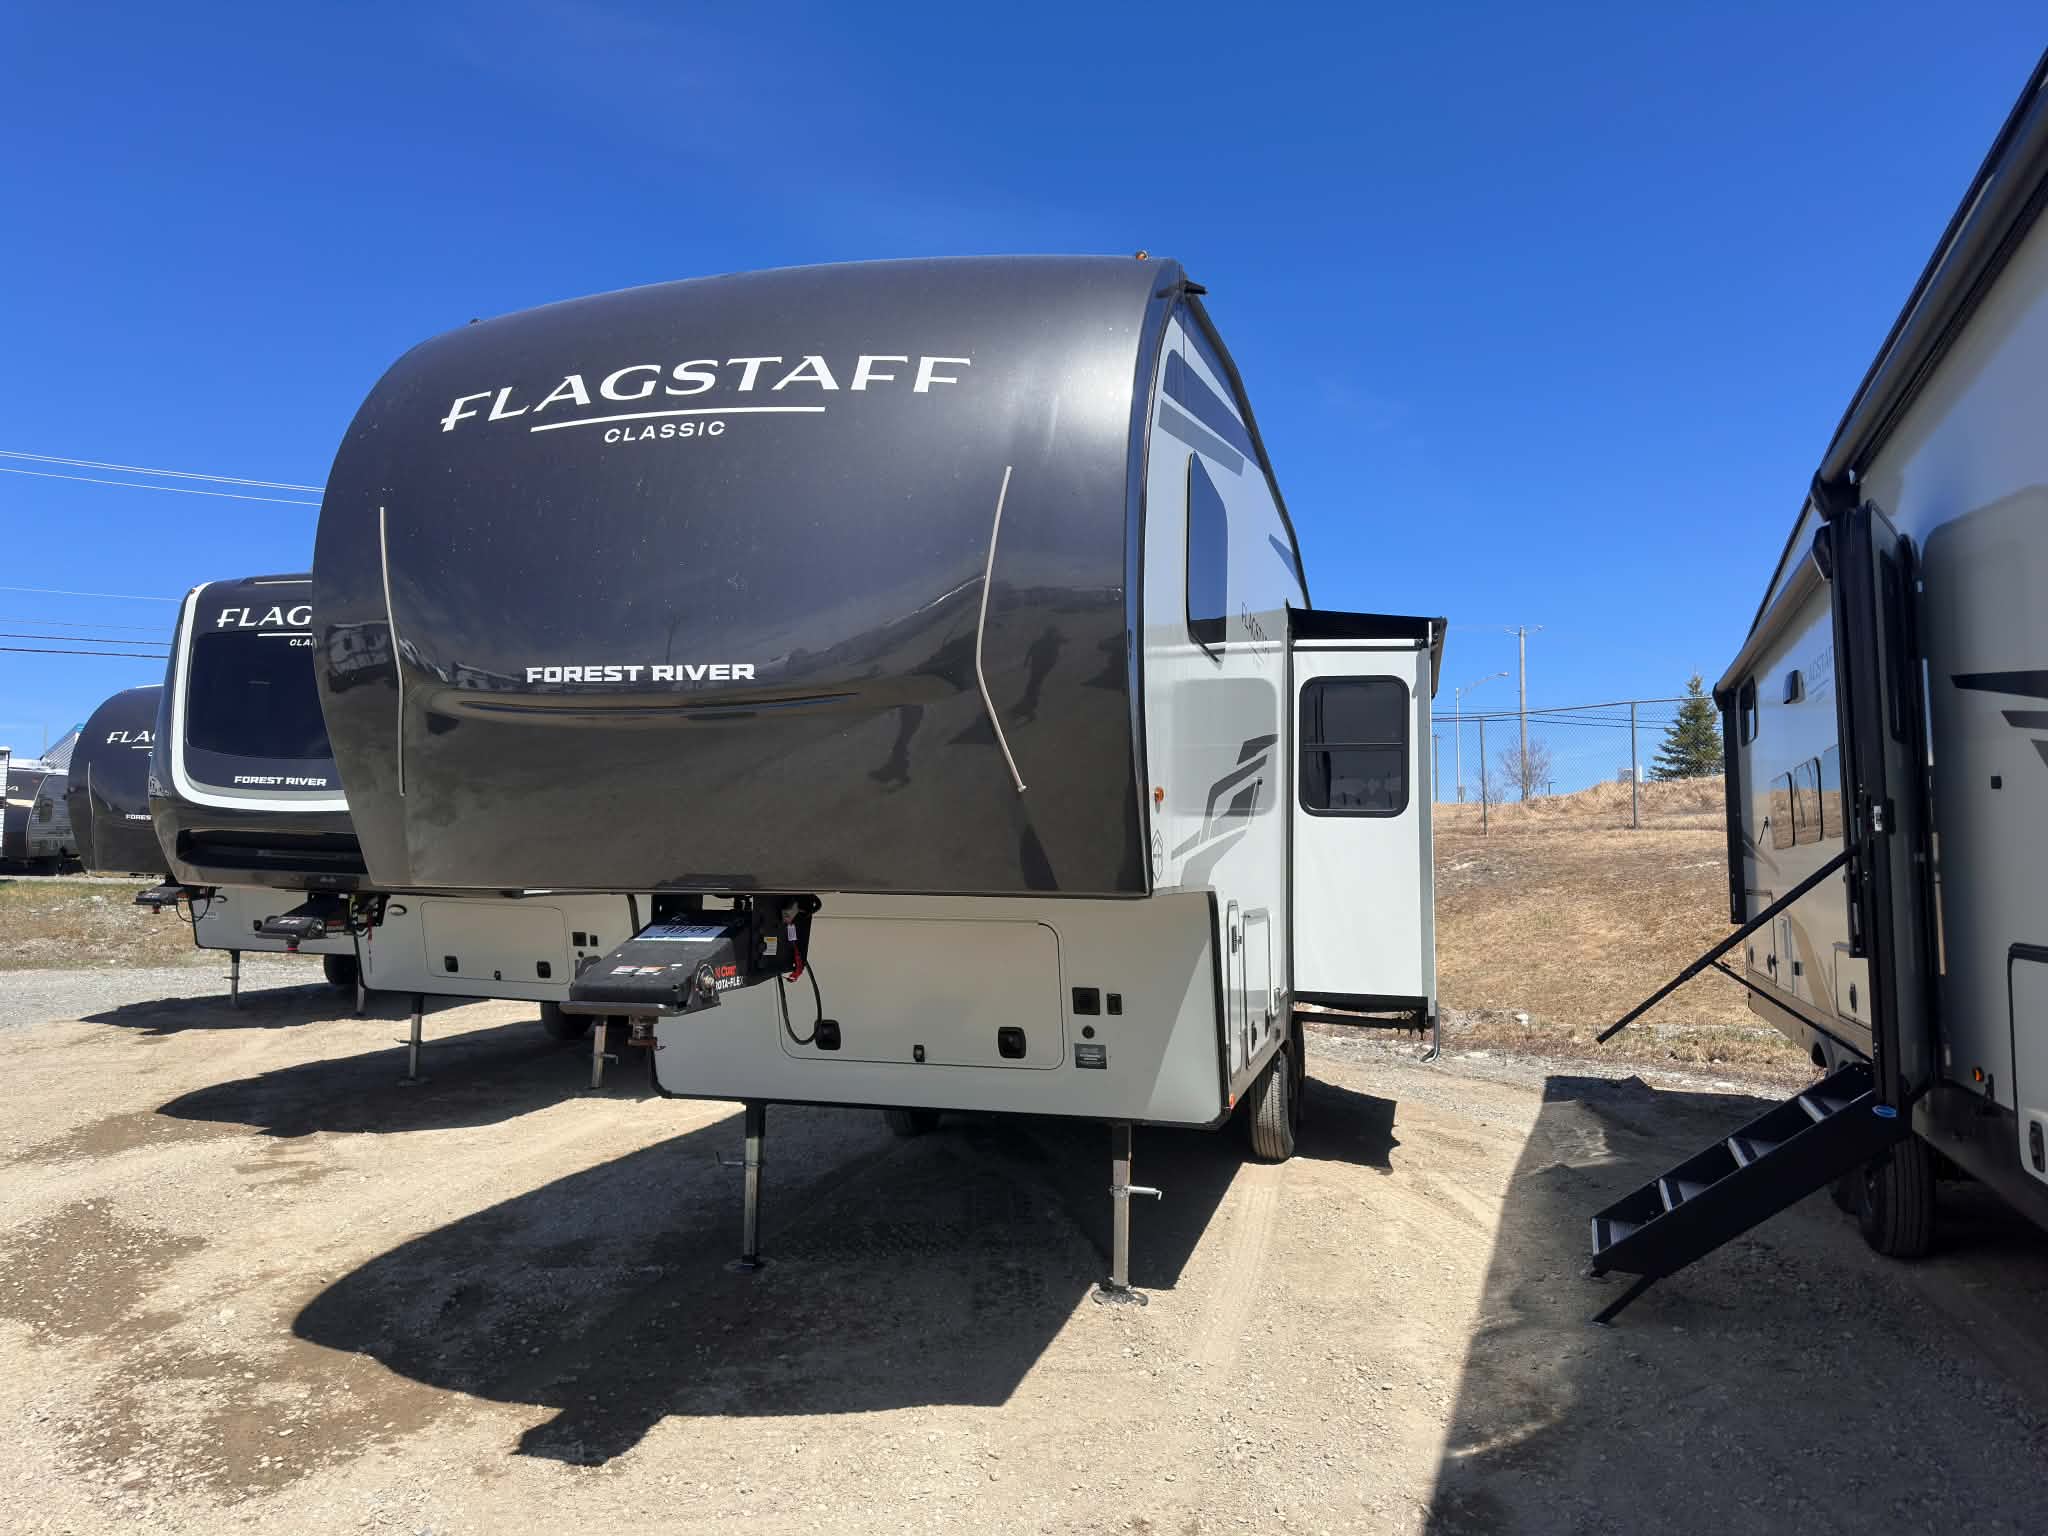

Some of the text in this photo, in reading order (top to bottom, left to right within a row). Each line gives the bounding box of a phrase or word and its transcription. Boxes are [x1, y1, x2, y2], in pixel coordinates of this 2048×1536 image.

[440, 355, 971, 432] FLAGSTAFF
[604, 421, 726, 444] CLASSIC
[289, 638, 312, 647] CLA
[526, 664, 756, 683] FOREST RIVER
[234, 776, 327, 787] FOREST RIVER
